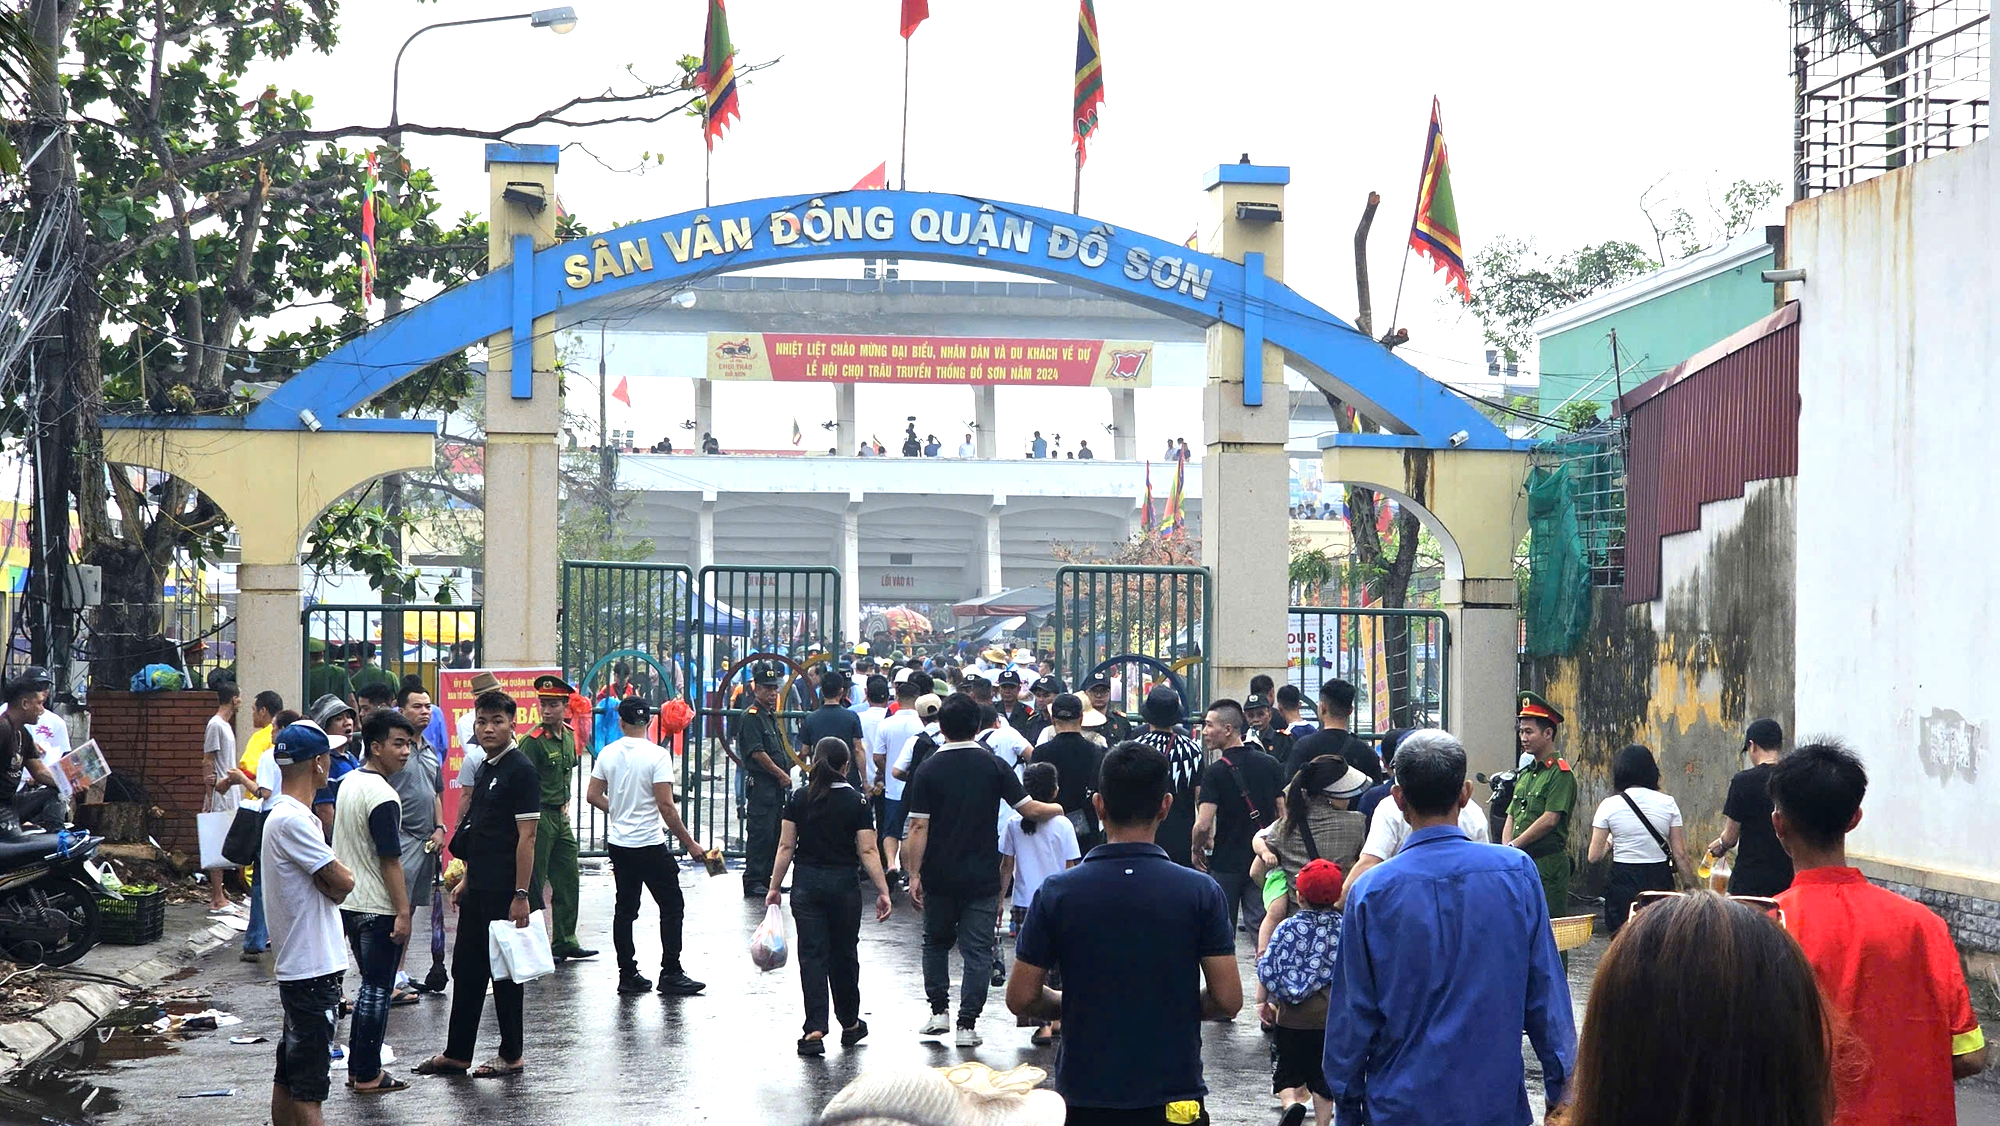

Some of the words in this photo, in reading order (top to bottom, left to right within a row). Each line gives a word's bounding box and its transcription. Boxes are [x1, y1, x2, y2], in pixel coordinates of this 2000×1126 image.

[564, 239, 653, 289] SÂN
[910, 204, 1034, 256] QUẬN
[1047, 224, 1115, 268] ĐỒ
[1123, 247, 1213, 300] SƠN
[775, 340, 803, 358] NHIỆT
[807, 341, 827, 359] LIỆT
[830, 341, 855, 357] CHÀO
[859, 342, 887, 357] MỪNG
[891, 344, 908, 360] ĐẠI
[911, 341, 936, 360] BIỂU,
[940, 345, 966, 359] NHÂN
[970, 345, 990, 360] DÂN
[994, 345, 1006, 360] VÀ
[1010, 347, 1023, 360] DU
[1027, 345, 1058, 361] KHÁCH
[1062, 345, 1074, 361] VỀ
[1077, 347, 1092, 363] DỰ
[806, 361, 818, 377] LỄ
[822, 363, 838, 379] HỘI
[842, 364, 864, 380] CHỌI
[868, 363, 892, 378] TRÂU
[896, 362, 931, 379] TRUYỀN
[936, 363, 966, 379] THỐNG
[970, 364, 983, 380] ĐỒ
[987, 366, 1006, 380] SƠN
[1010, 365, 1032, 380] NĂM
[1036, 368, 1059, 381] 2024
[516, 704, 543, 724] BÁ
